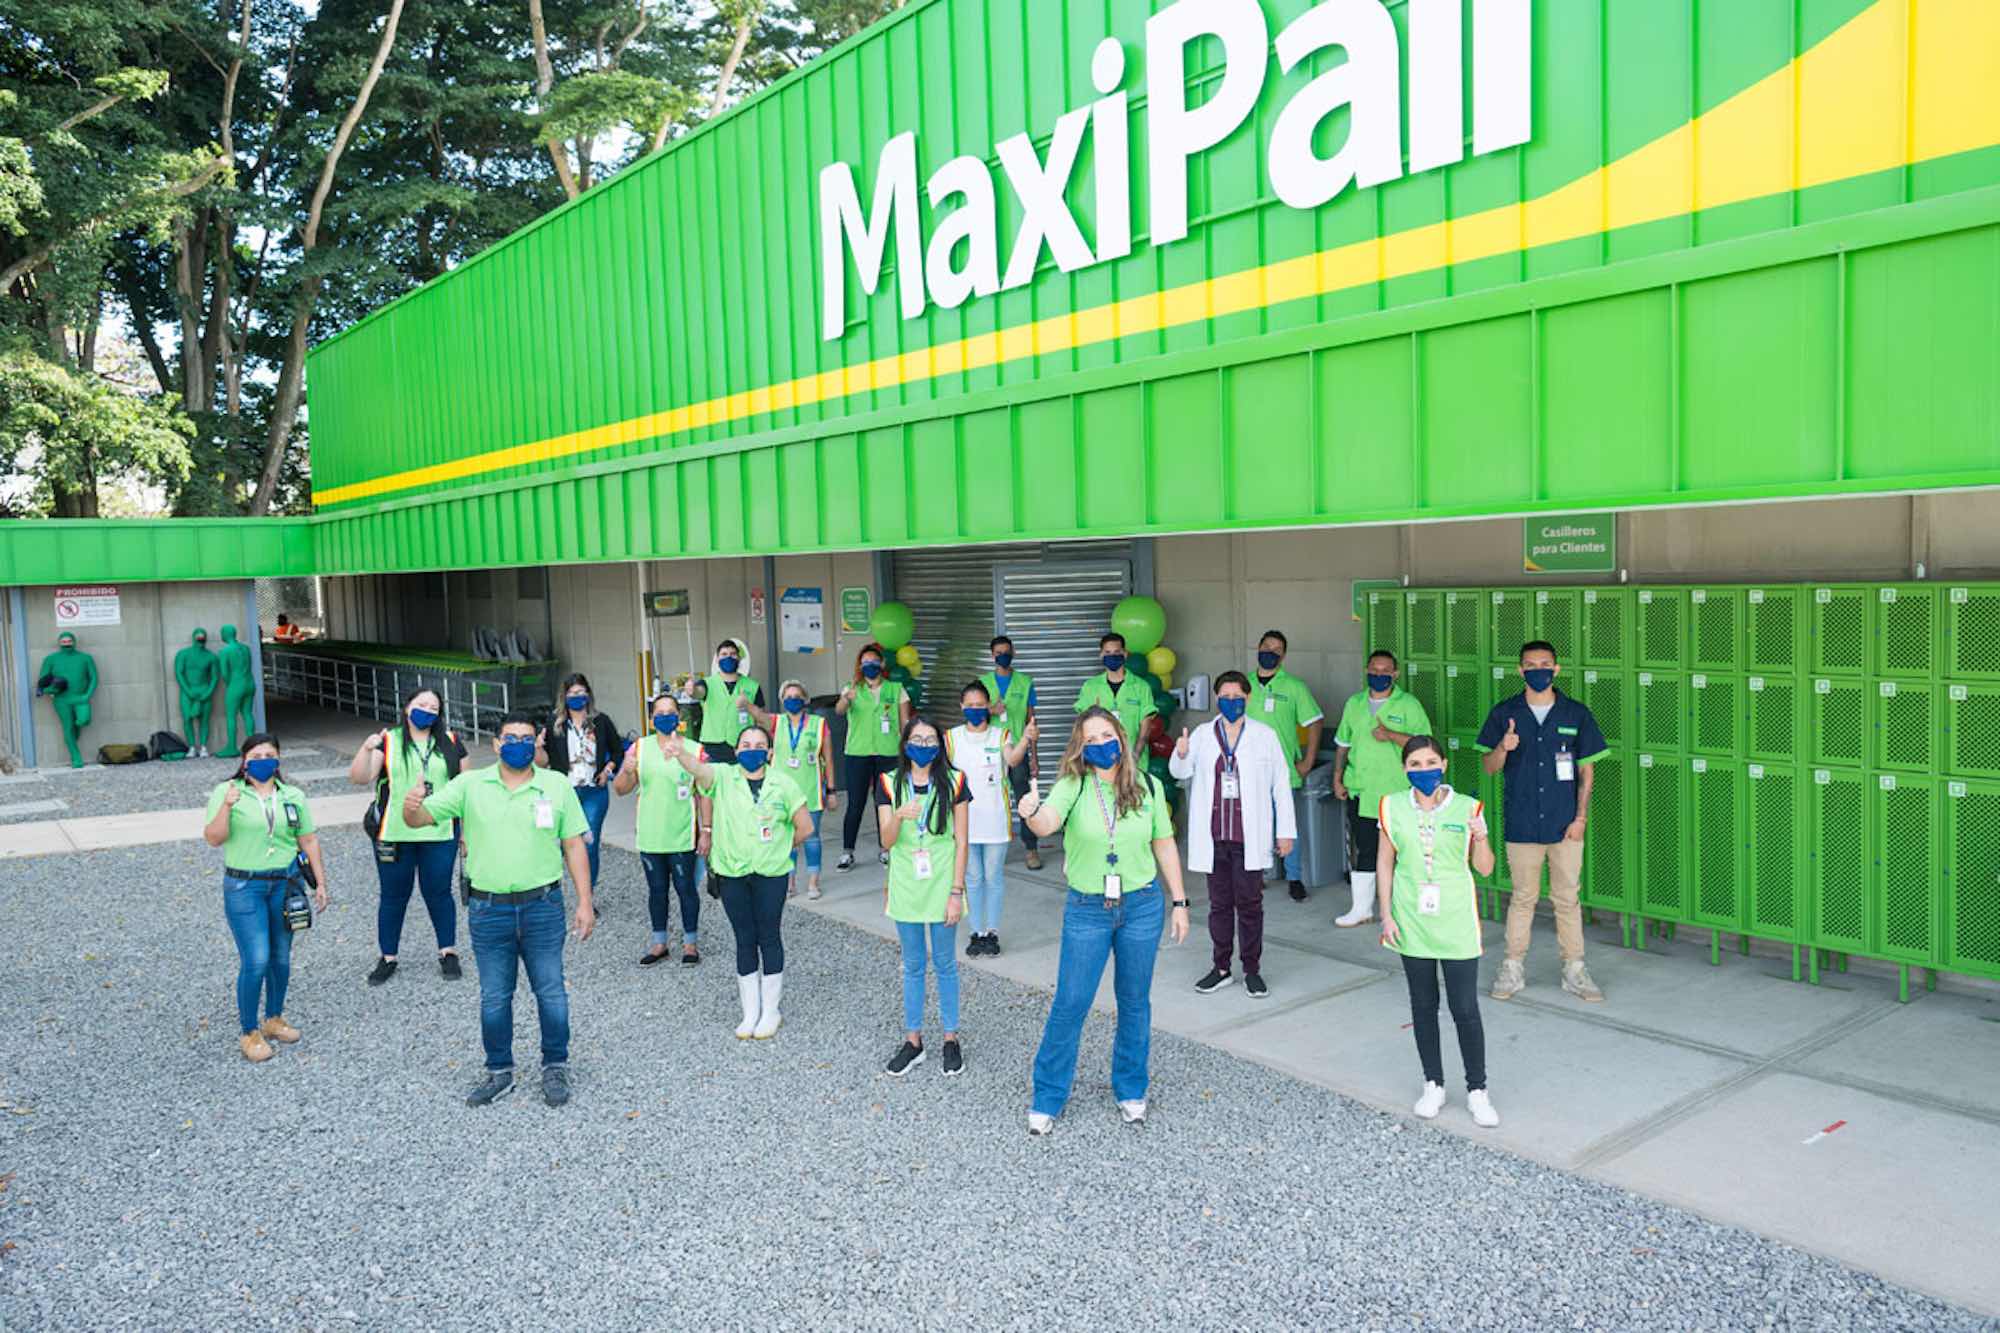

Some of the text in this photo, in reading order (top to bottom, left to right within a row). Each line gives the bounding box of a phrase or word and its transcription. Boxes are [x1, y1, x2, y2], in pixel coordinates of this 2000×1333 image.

[1541, 525, 1596, 538] Casilleros
[1532, 542, 1606, 557] para Clientes
[56, 587, 116, 596] PROHIBIDO
